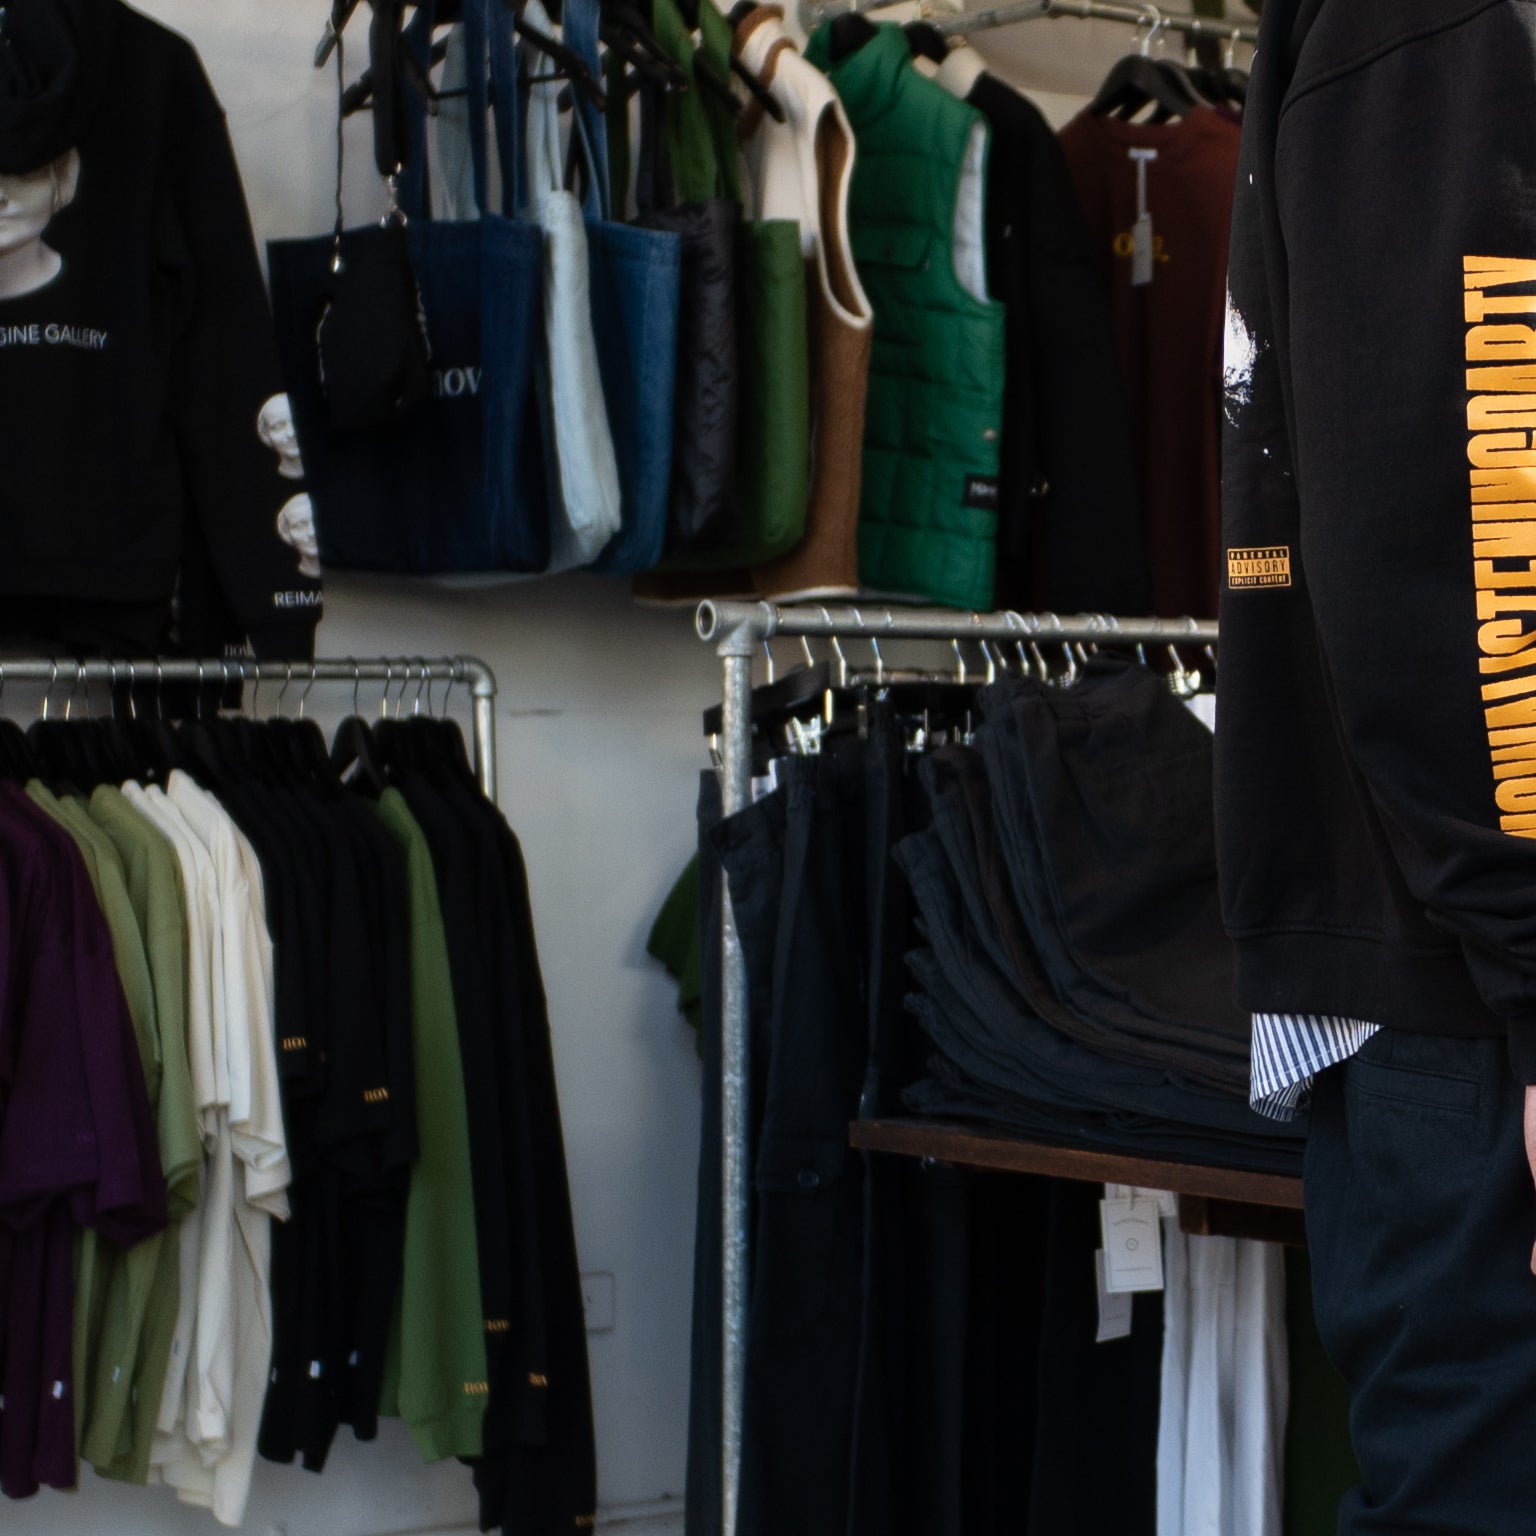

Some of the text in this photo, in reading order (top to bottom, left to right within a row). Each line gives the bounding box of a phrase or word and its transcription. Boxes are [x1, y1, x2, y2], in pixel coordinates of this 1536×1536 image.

[44, 323, 107, 349] GALLERY
[1230, 550, 1284, 560] PARENTAL
[1231, 559, 1286, 574] ADVISORY
